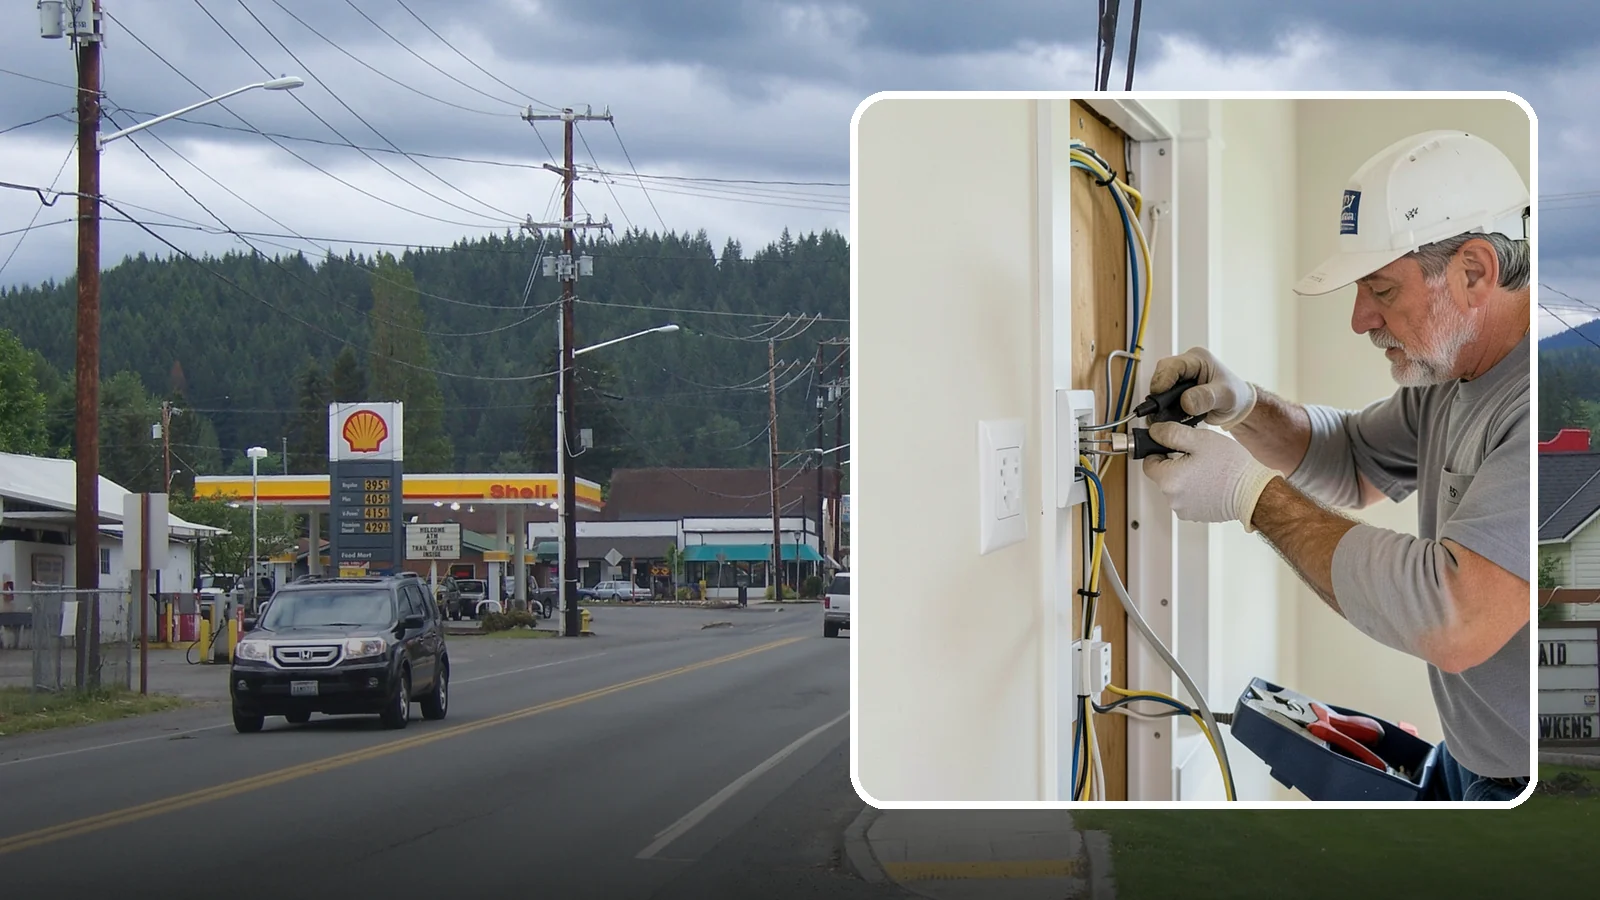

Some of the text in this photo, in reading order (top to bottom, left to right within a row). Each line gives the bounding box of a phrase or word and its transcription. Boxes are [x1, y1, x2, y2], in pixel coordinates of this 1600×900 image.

[366, 480, 383, 490] 395
[490, 484, 547, 498] Shell
[366, 494, 383, 504] 405
[366, 508, 383, 518] 415
[366, 522, 383, 533] 429
